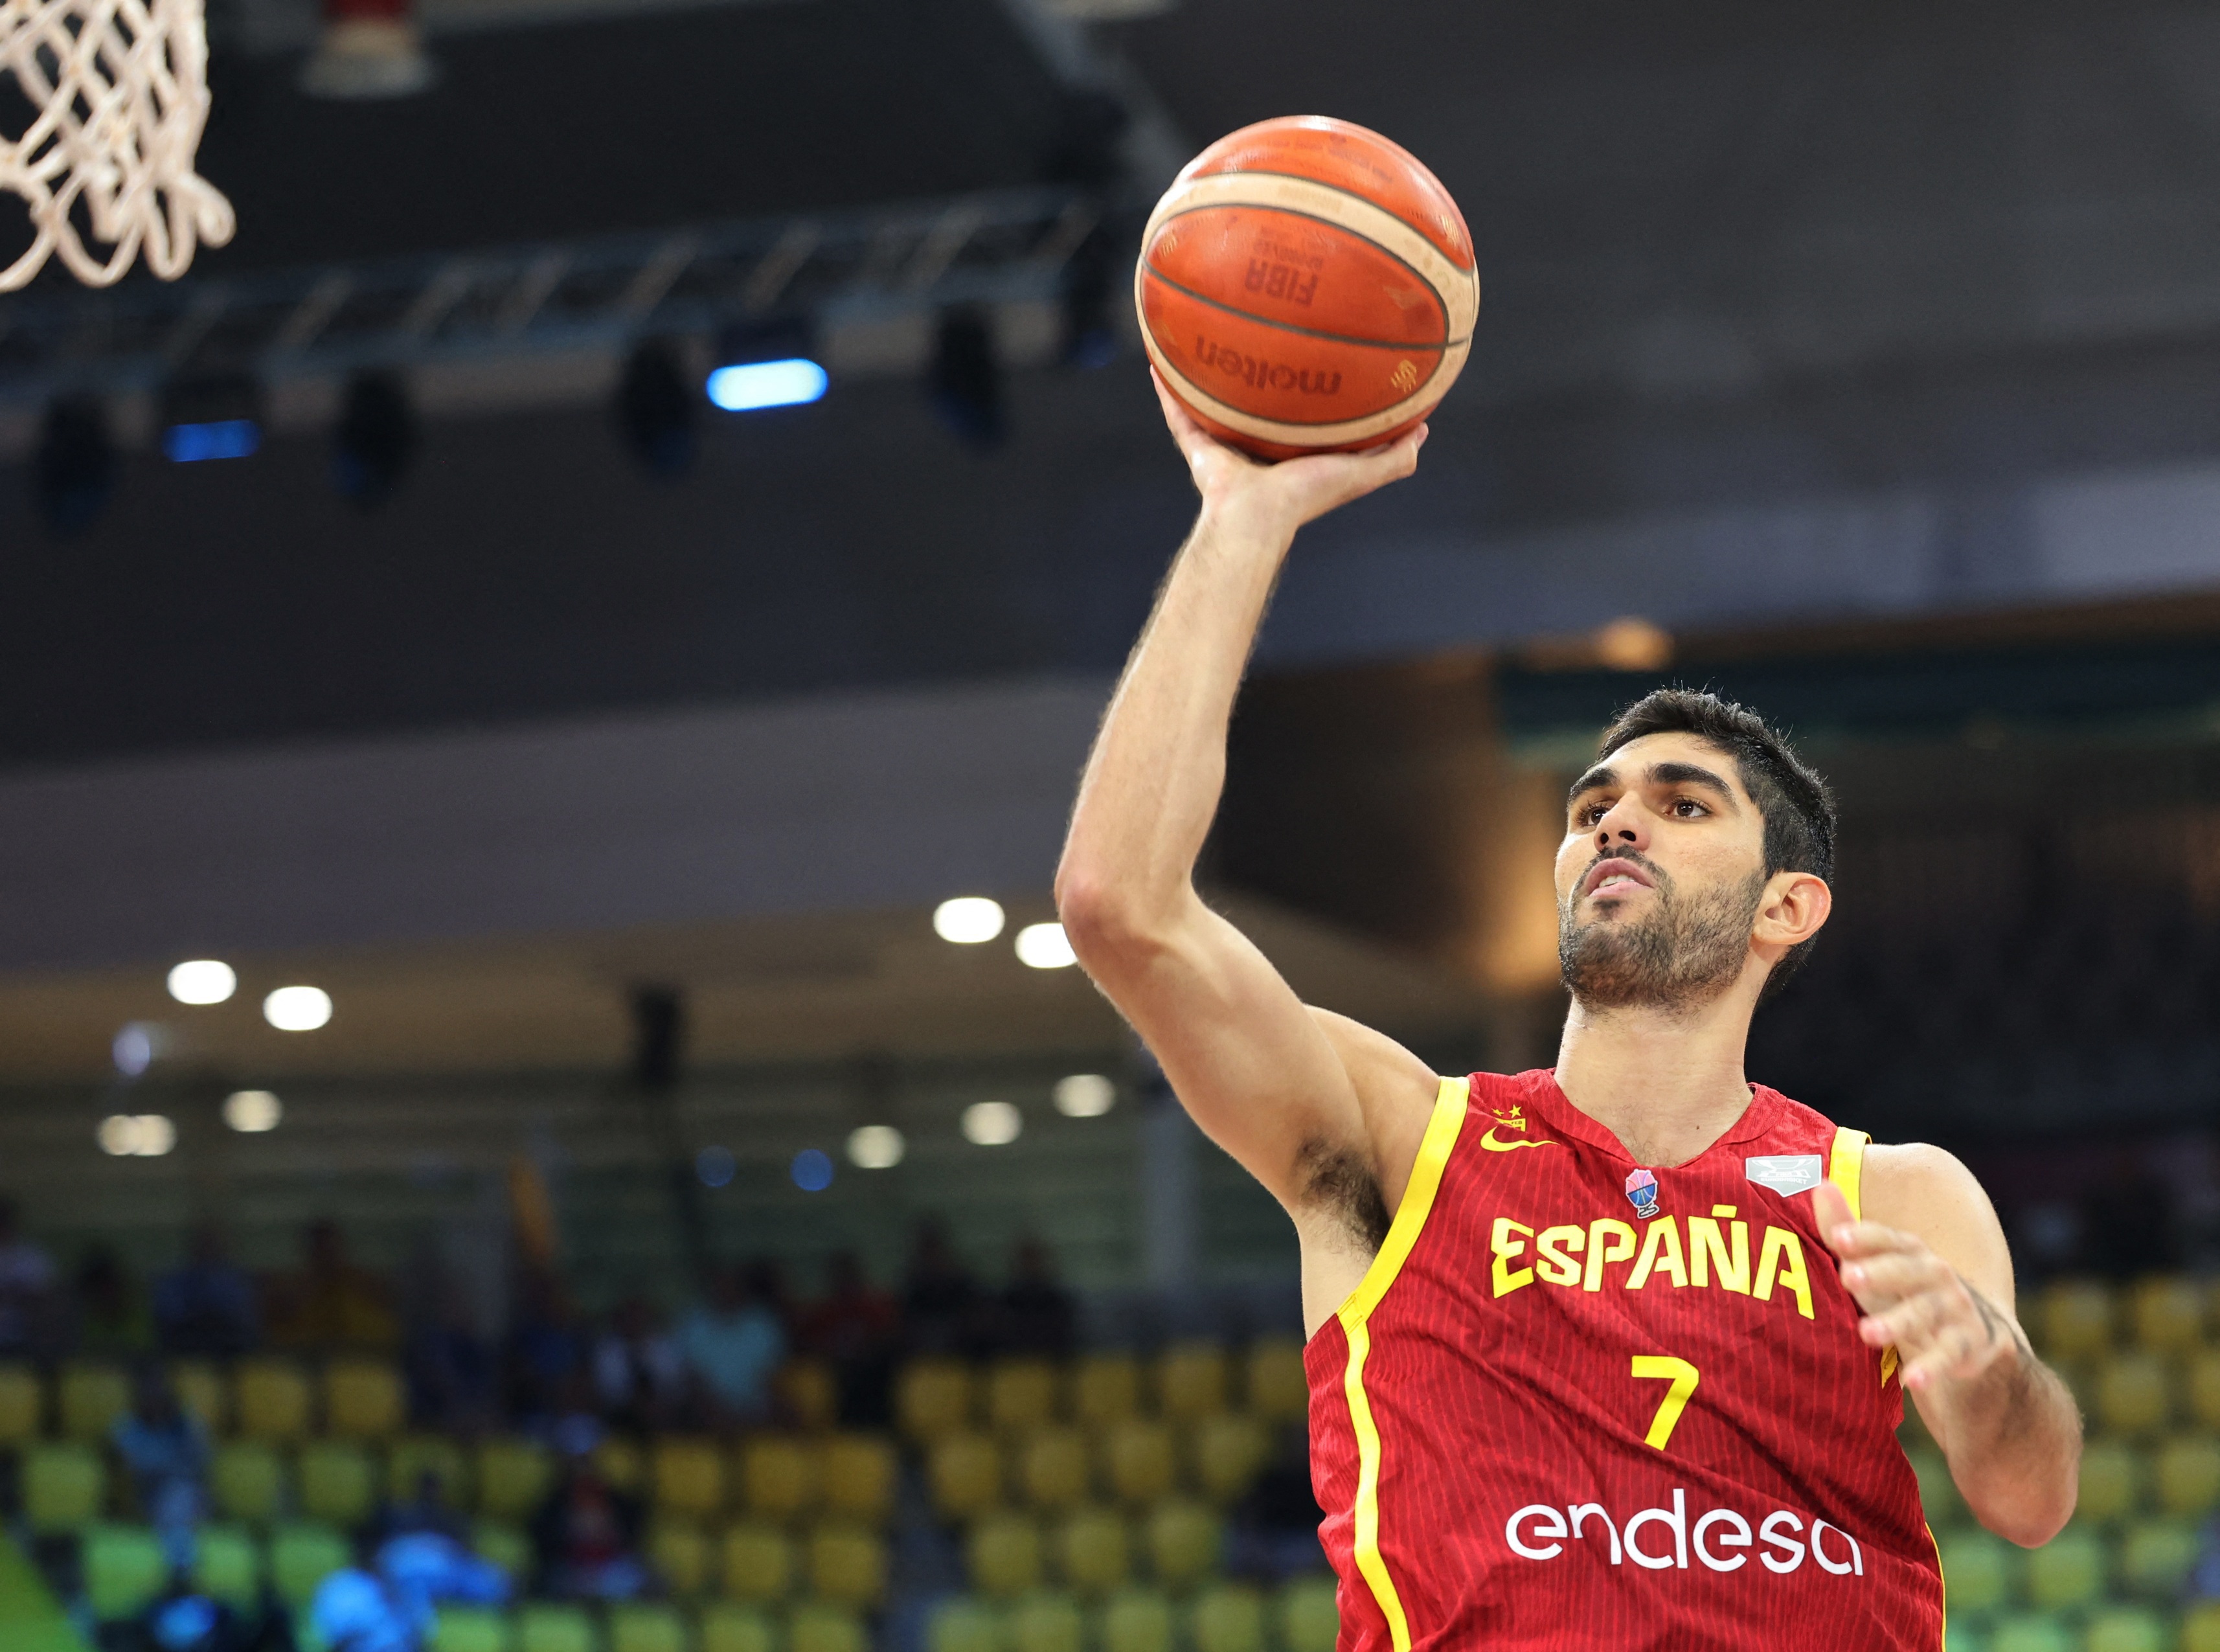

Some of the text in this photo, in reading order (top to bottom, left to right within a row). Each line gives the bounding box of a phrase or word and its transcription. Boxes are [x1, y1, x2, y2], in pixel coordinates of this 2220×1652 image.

[1243, 258, 1320, 308] FIBA
[1195, 334, 1342, 396] molten
[1639, 1203, 1658, 1217] 25
[1491, 1205, 1815, 1320] ESPAÑA
[1631, 1355, 1699, 1451] 7
[1506, 1488, 1863, 1576] endesa
